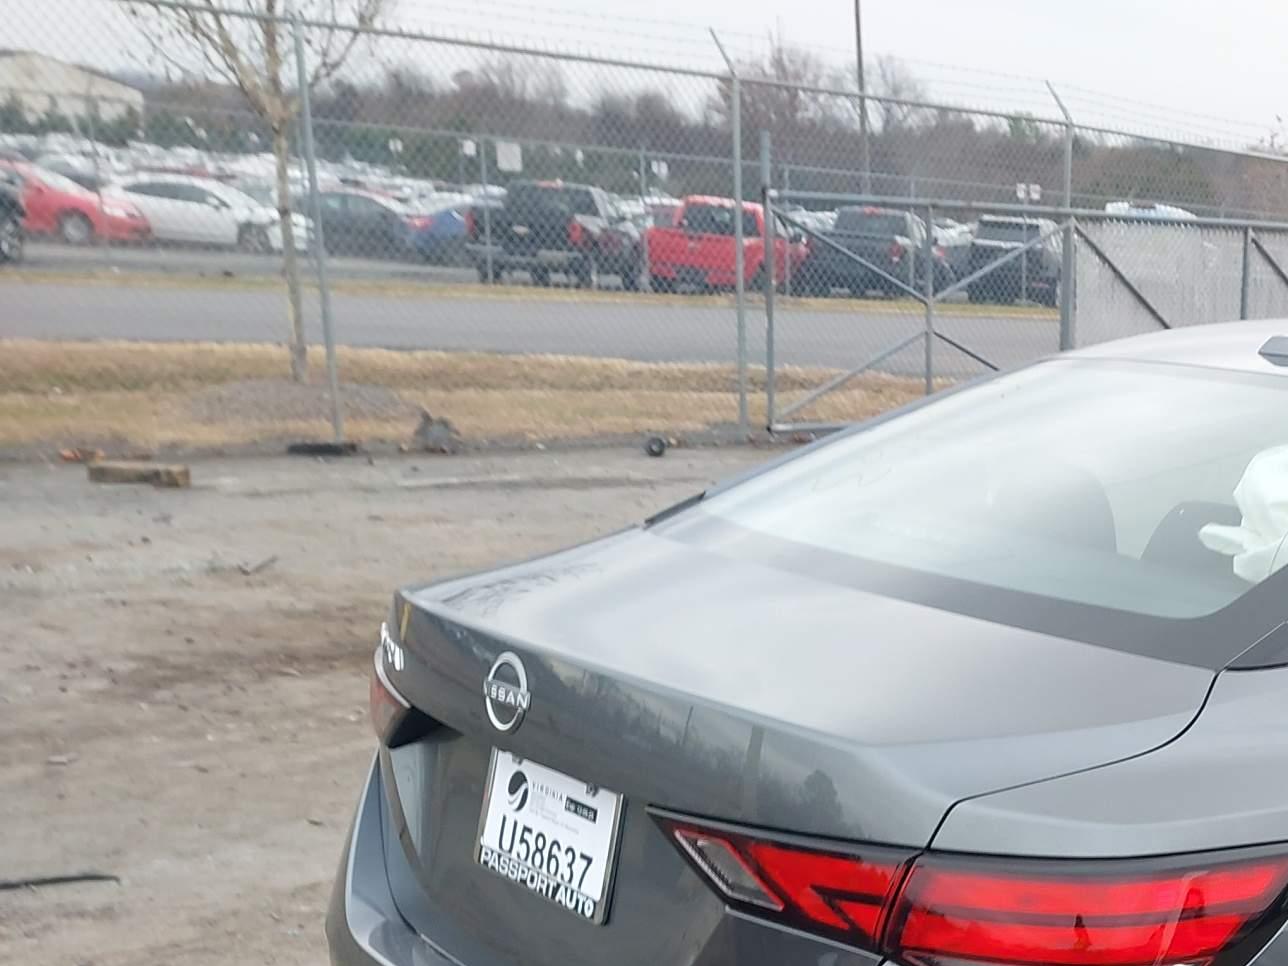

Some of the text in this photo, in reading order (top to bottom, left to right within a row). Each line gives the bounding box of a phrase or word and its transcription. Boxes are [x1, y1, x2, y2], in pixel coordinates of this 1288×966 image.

[483, 680, 531, 709] ISSAN
[480, 845, 596, 919] PASSPORT AUTO
[498, 814, 594, 890] U58637
